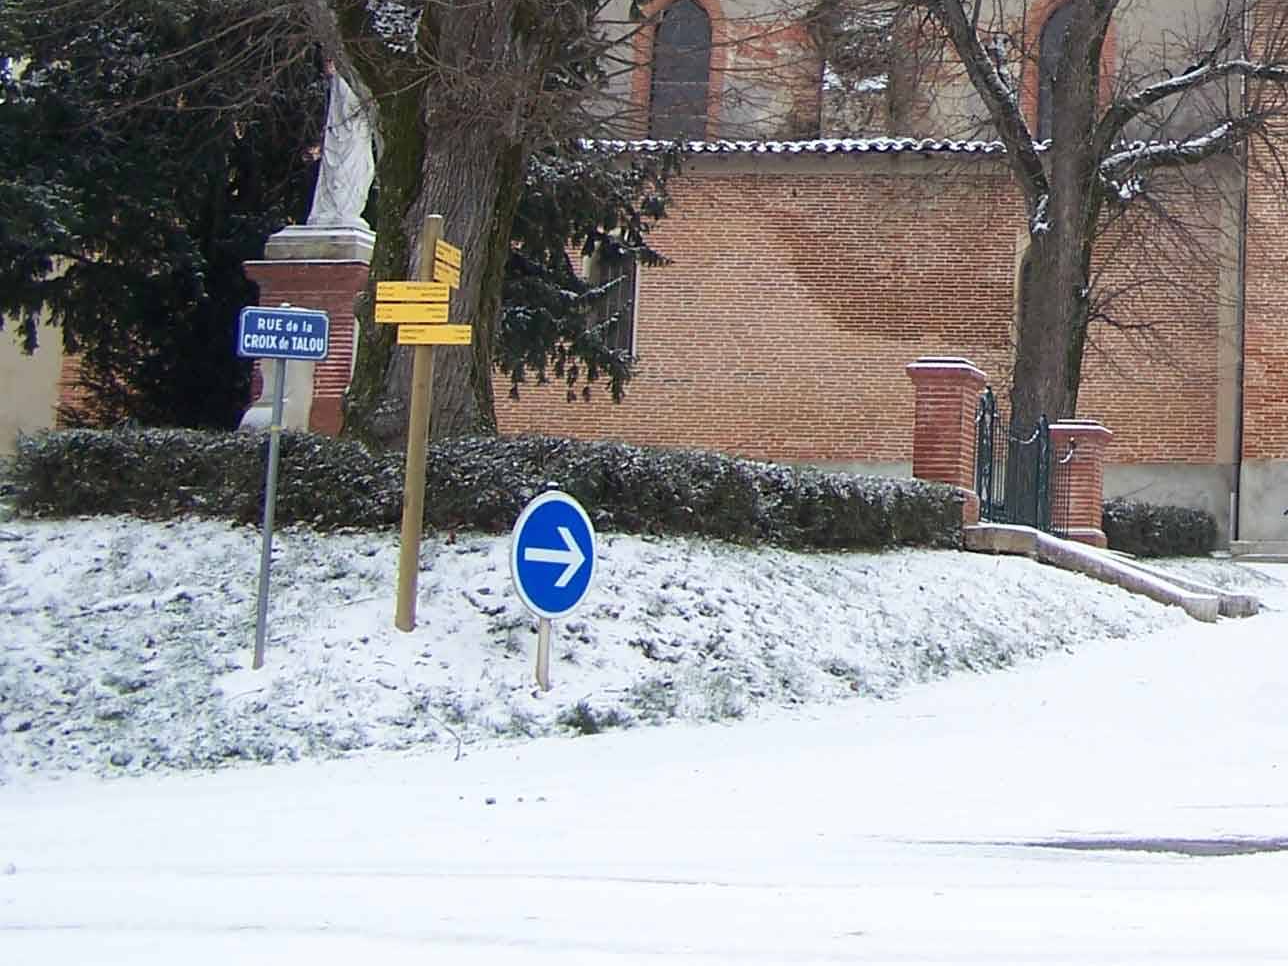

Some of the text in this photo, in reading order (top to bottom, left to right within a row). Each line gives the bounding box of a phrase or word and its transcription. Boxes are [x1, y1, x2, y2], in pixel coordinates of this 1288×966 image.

[257, 318, 313, 333] RUE de la
[244, 334, 324, 352] CROIX de TALOU
